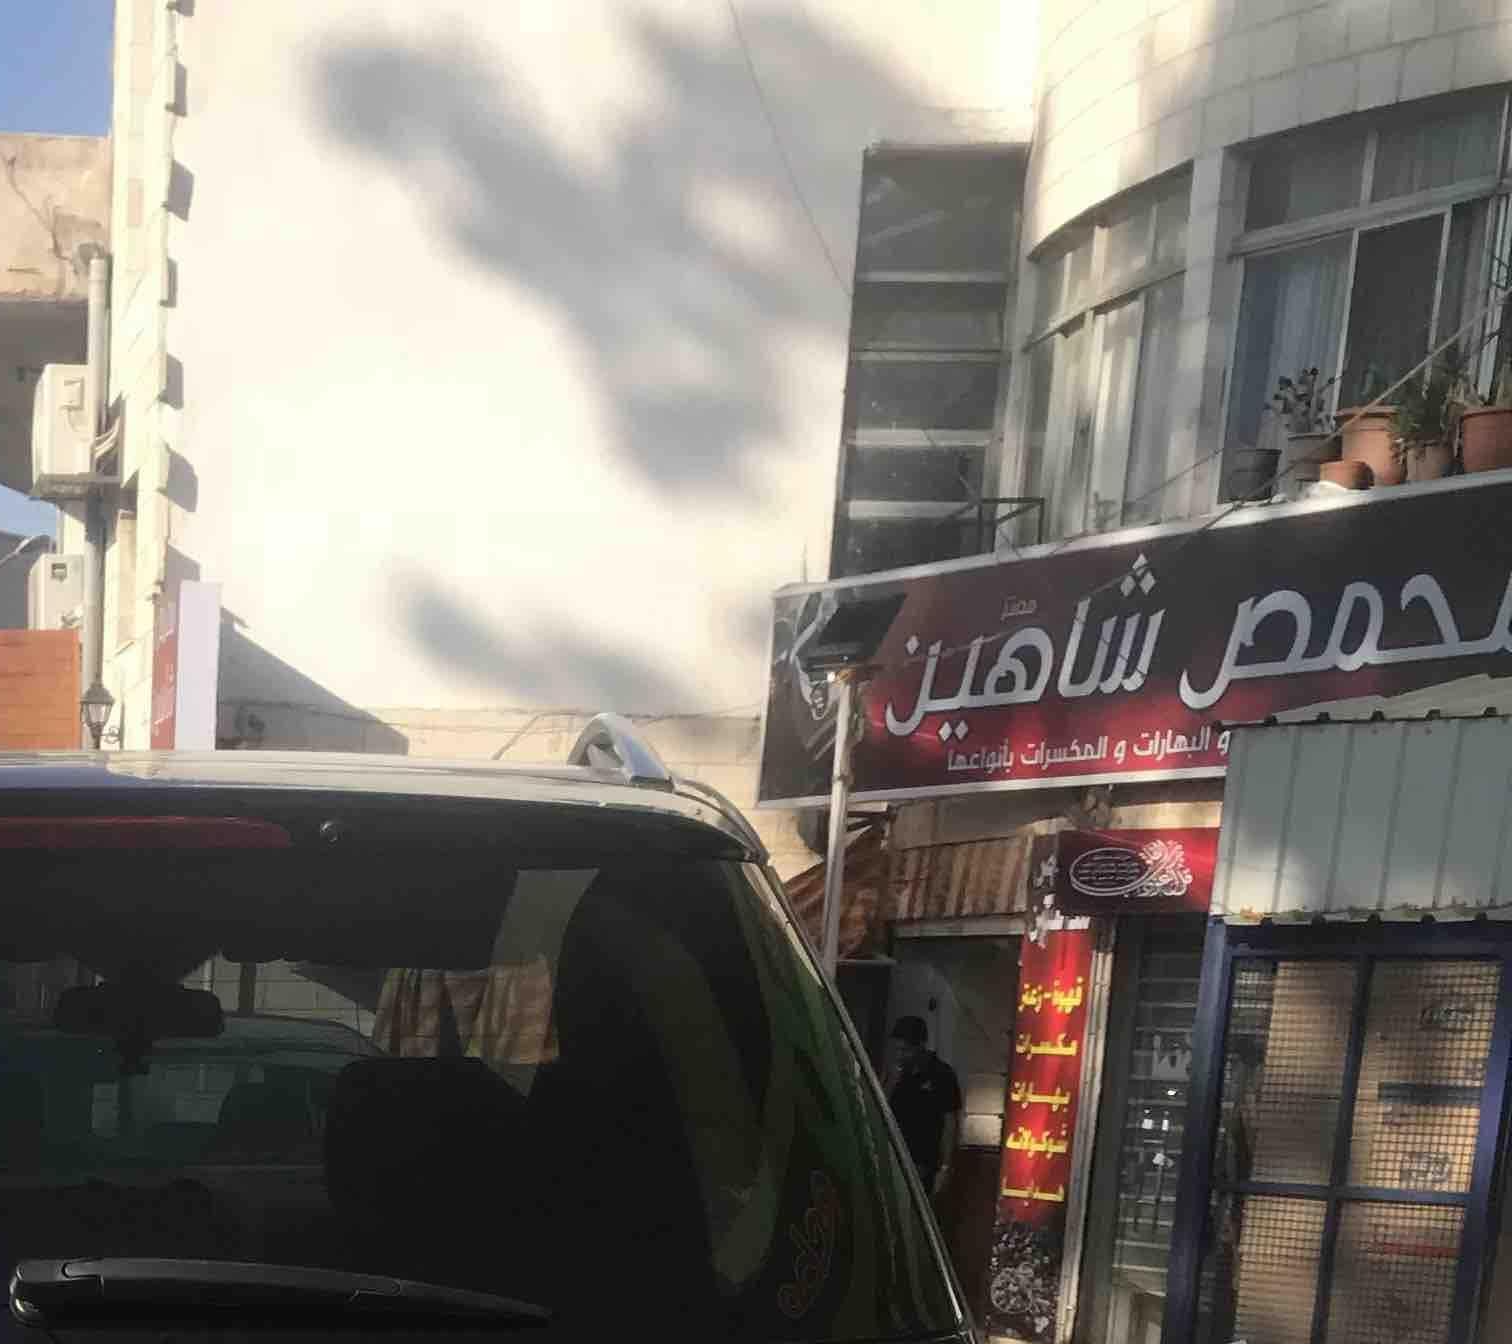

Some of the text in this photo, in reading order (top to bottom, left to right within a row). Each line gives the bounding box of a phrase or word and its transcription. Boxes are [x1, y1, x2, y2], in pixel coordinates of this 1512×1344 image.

[886, 553, 1166, 736] شاهين
[1021, 736, 1108, 769] المكسرات
[1133, 726, 1210, 761] البهارات
